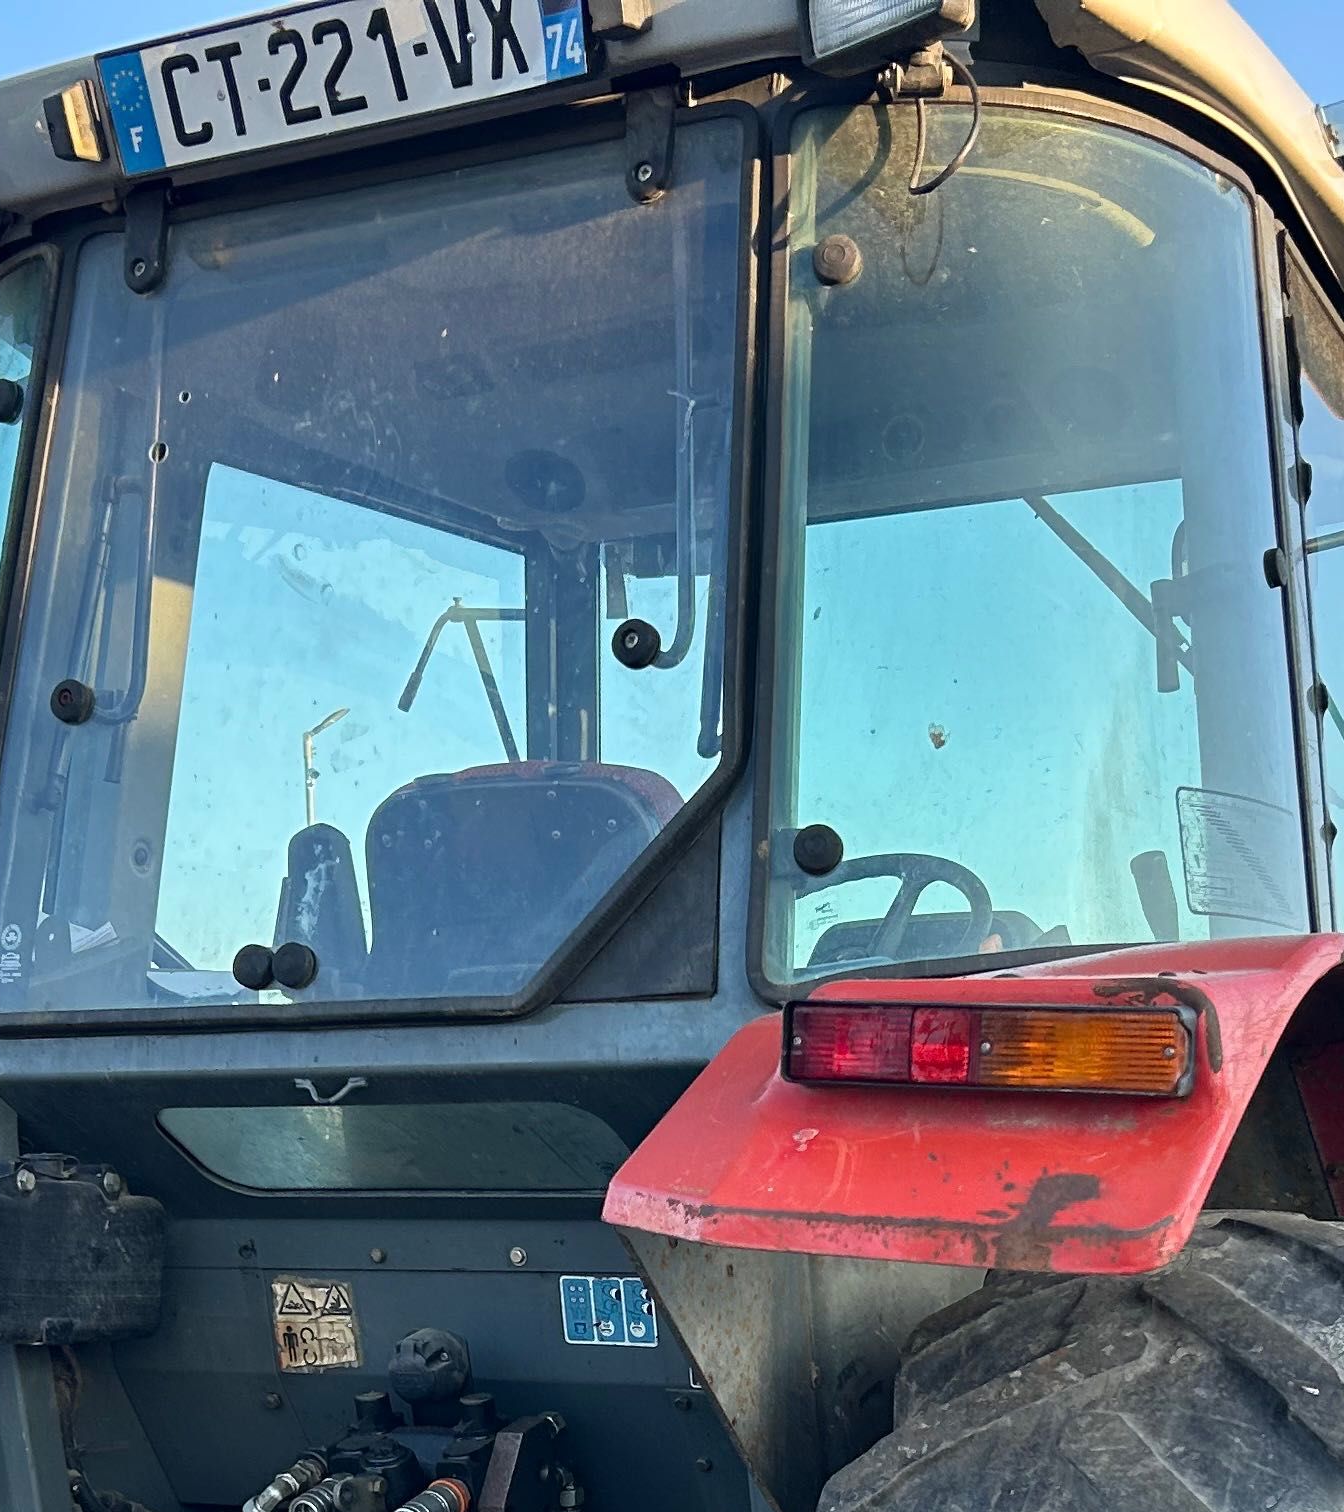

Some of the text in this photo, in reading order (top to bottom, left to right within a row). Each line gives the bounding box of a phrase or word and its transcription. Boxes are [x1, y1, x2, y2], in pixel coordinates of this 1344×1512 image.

[129, 0, 581, 154] F CT-221-VX 74
